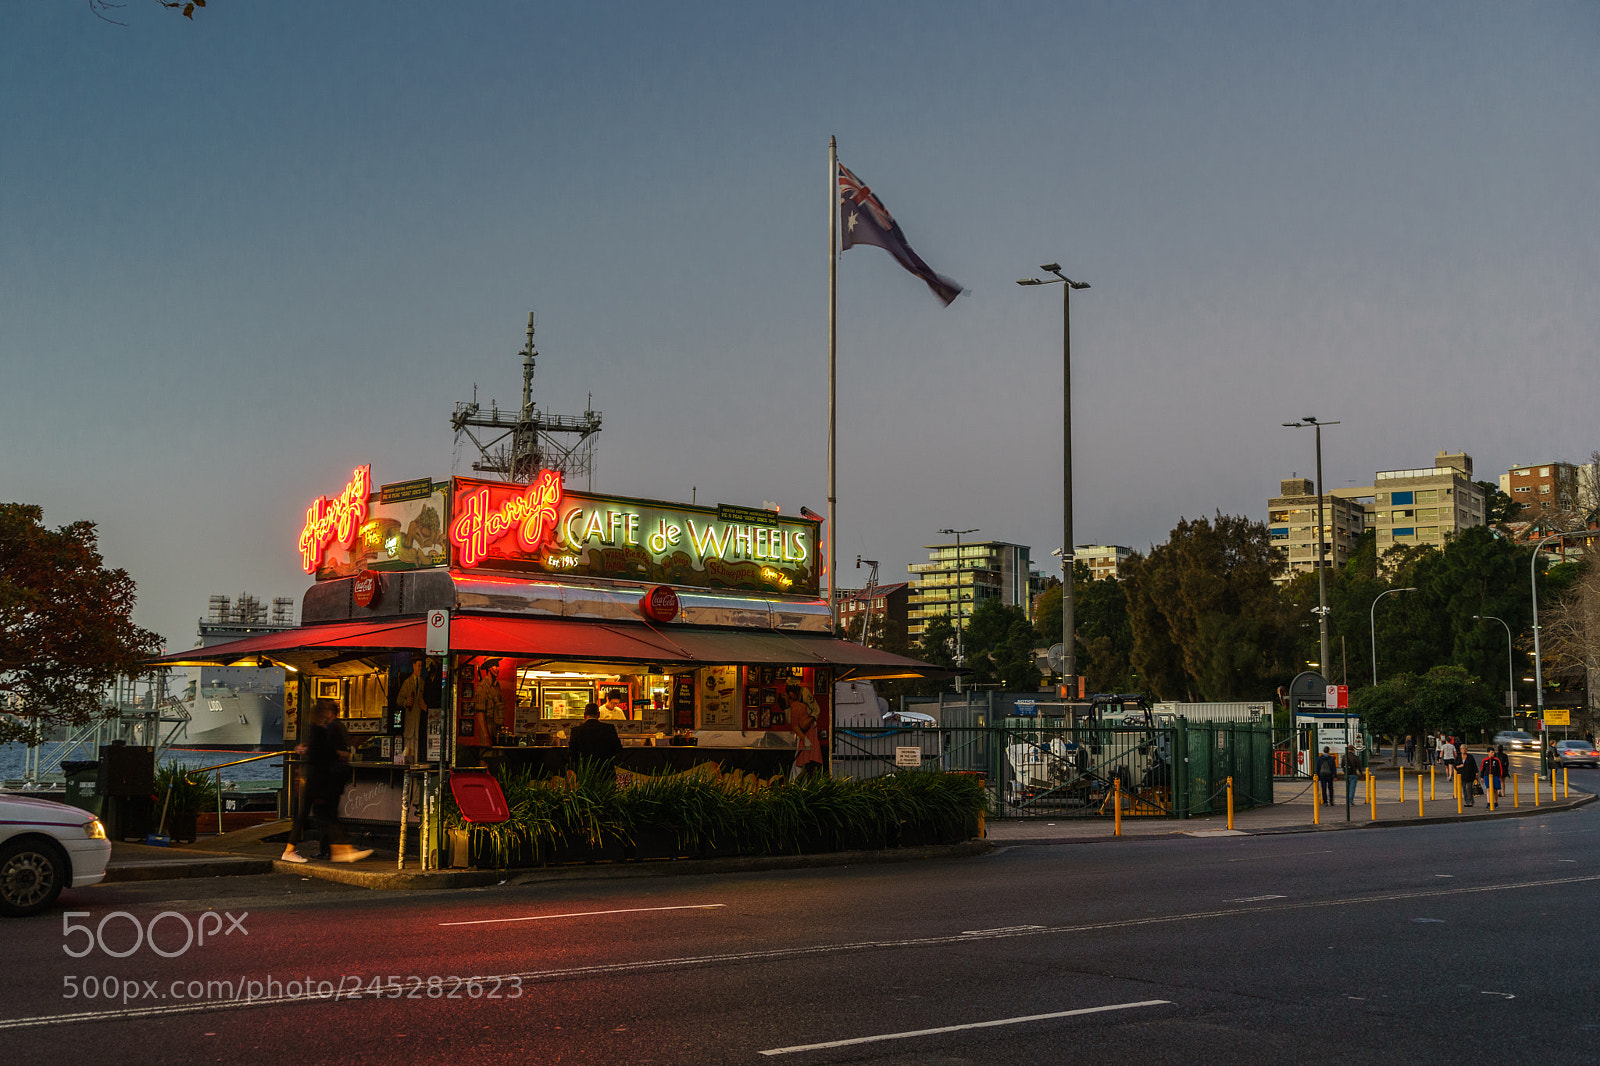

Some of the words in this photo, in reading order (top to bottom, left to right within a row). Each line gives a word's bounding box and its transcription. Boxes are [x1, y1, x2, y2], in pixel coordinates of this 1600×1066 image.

[298, 464, 370, 574] Harry's
[451, 469, 563, 568] Harry's
[564, 508, 639, 555] CAFE
[649, 517, 681, 554] de
[686, 519, 808, 564] WHEELS
[562, 556, 578, 568] 1945
[709, 562, 755, 581] Schweppes
